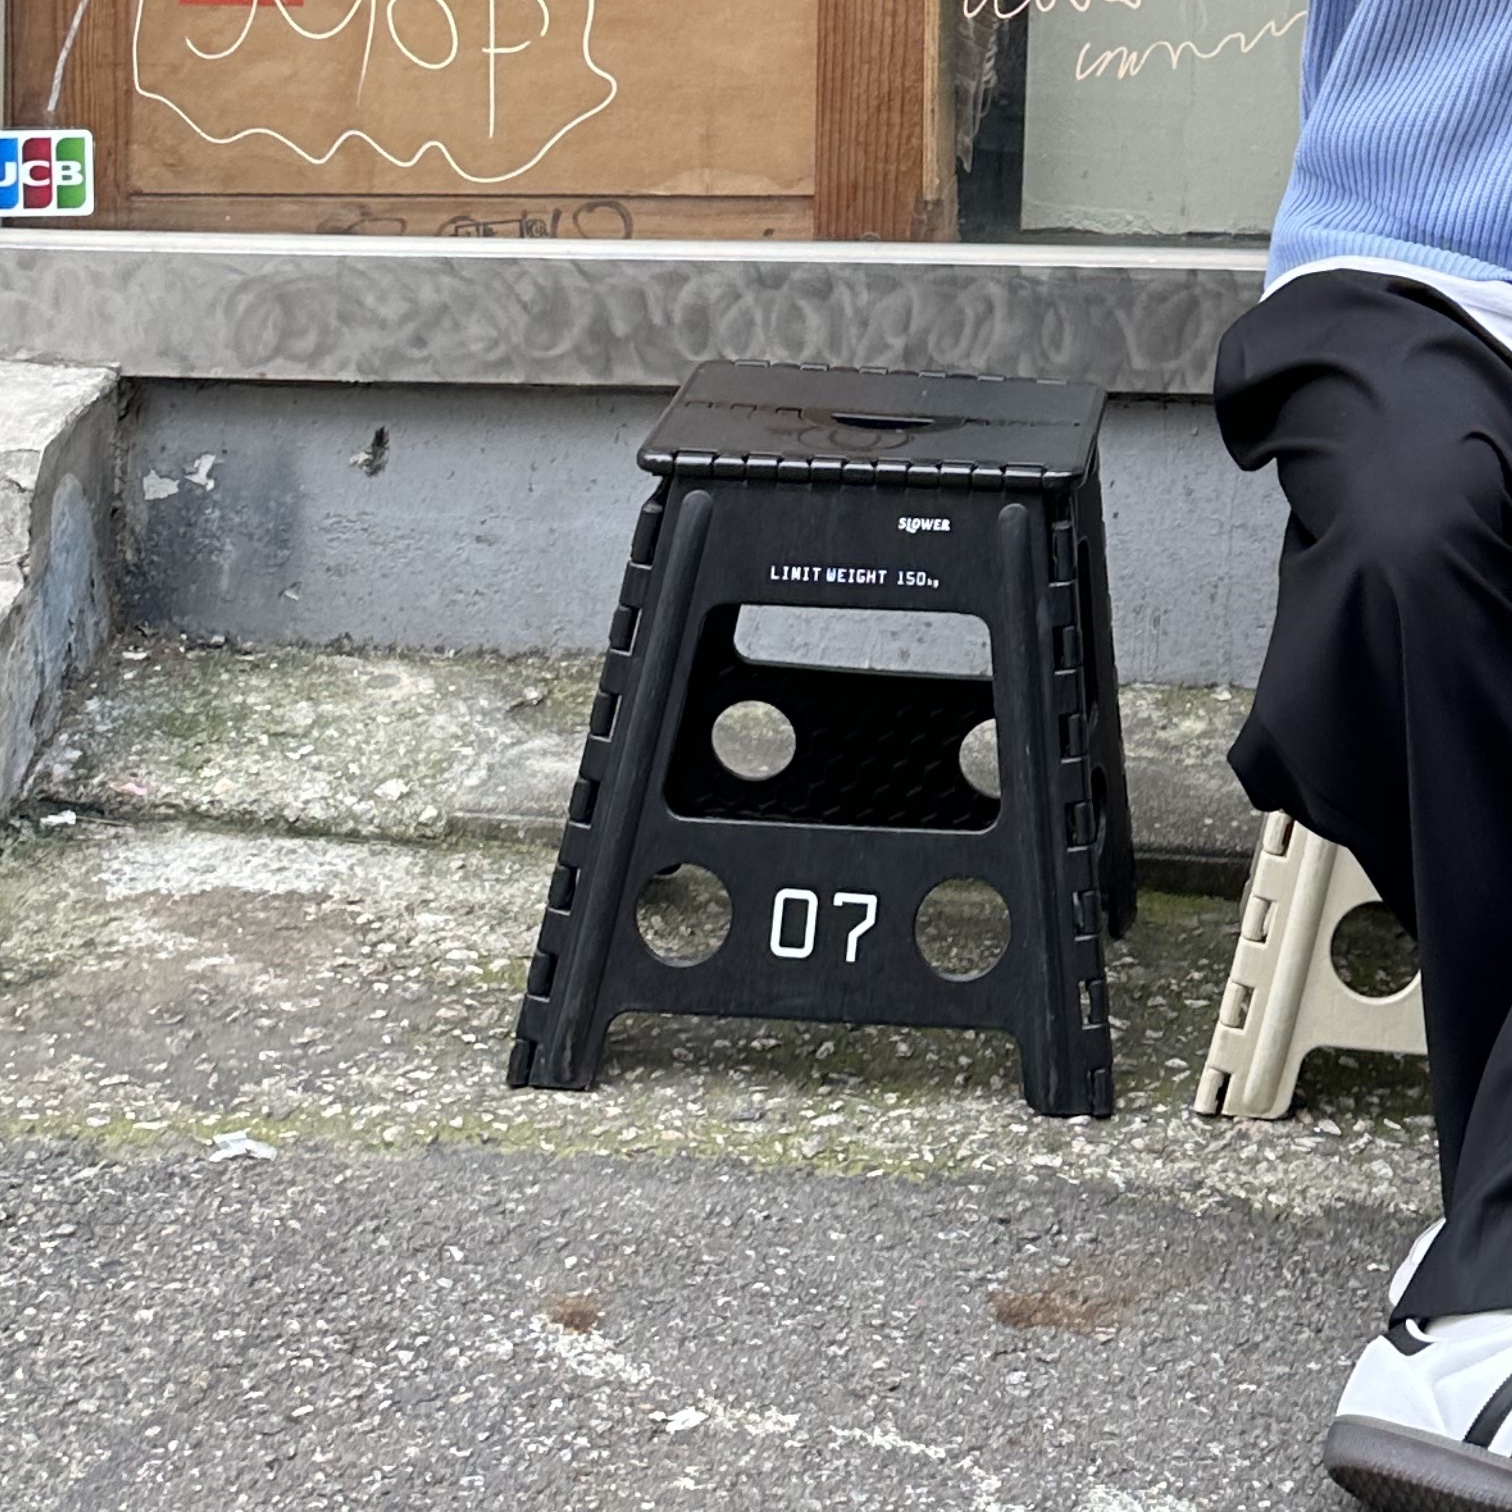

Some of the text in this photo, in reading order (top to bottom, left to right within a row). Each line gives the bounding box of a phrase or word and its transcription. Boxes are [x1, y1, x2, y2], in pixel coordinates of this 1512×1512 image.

[0, 159, 84, 187] JCB
[898, 517, 951, 534] SLOWER
[770, 565, 822, 582] LIMIT
[826, 568, 887, 584] WEIGHT
[769, 887, 878, 963] 07
